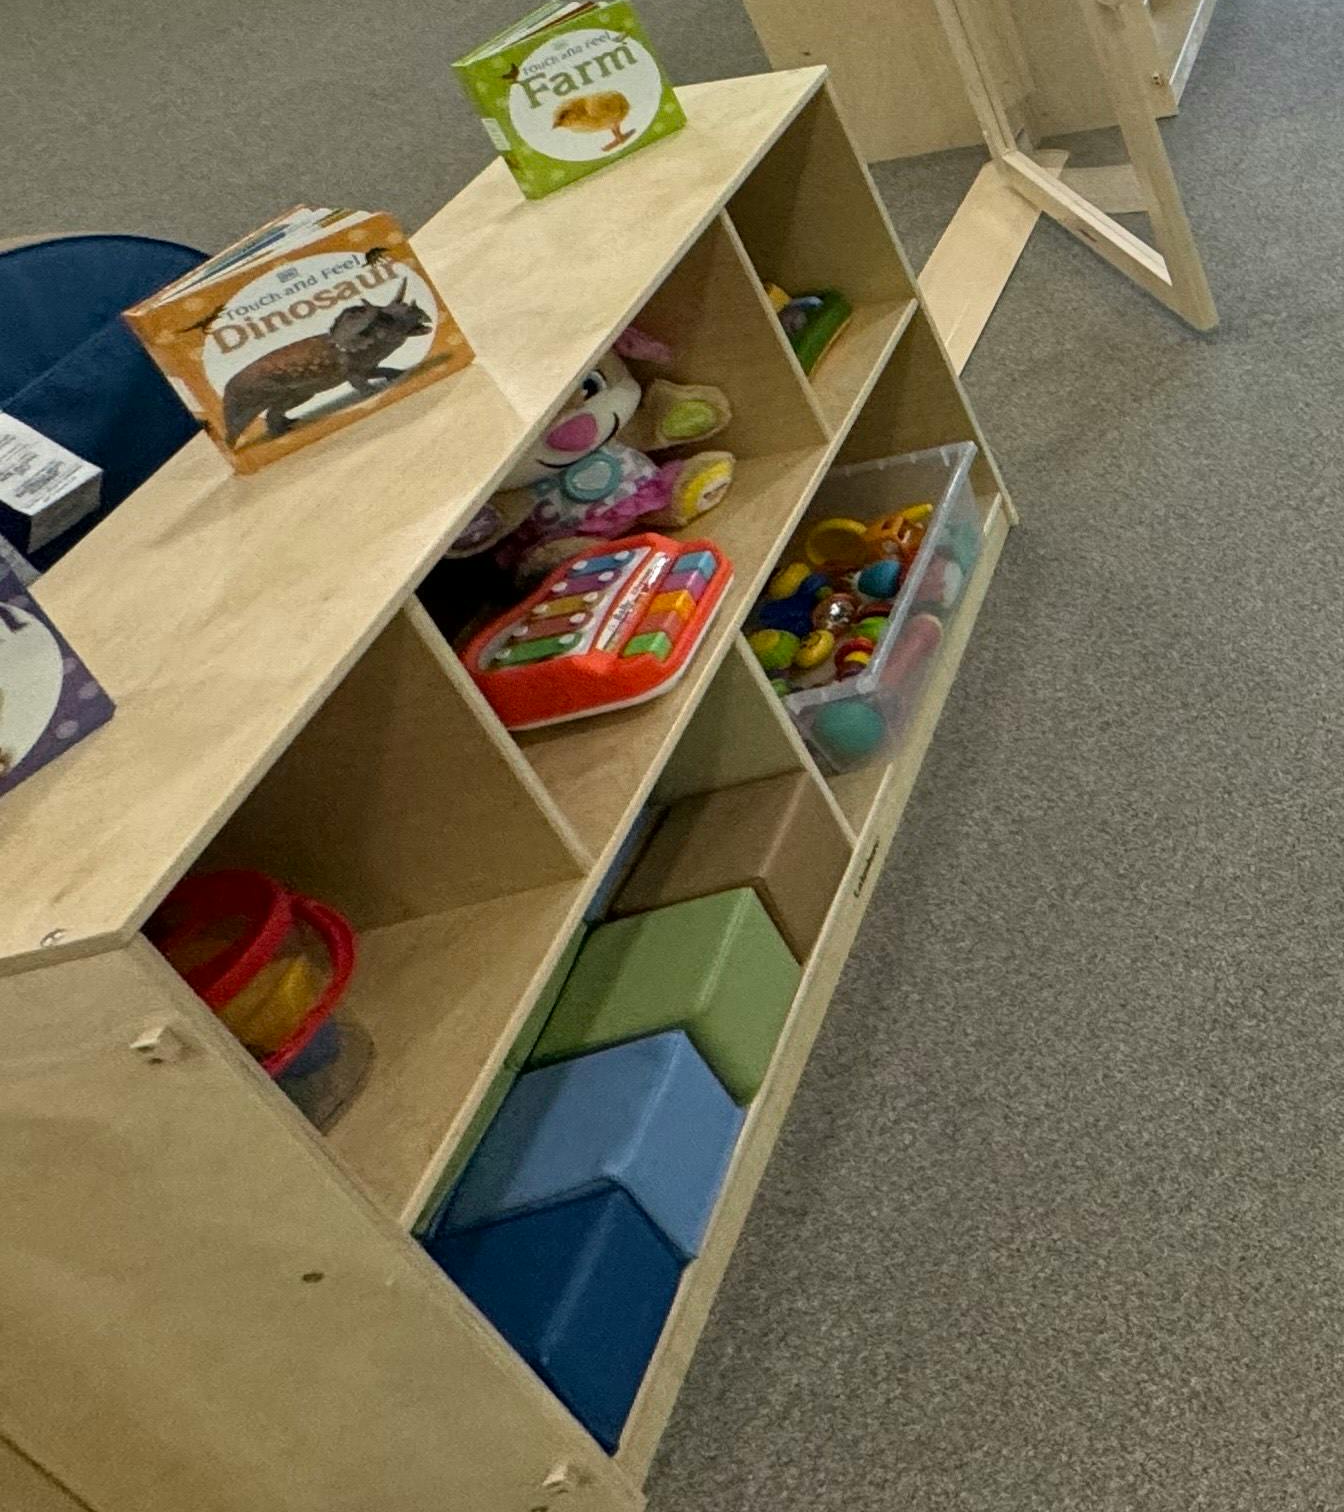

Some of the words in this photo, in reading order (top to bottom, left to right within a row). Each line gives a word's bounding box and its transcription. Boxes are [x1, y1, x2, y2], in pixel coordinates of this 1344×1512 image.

[519, 45, 638, 109] Farm
[321, 254, 361, 280] Feel
[212, 259, 399, 354] Dinosaur
